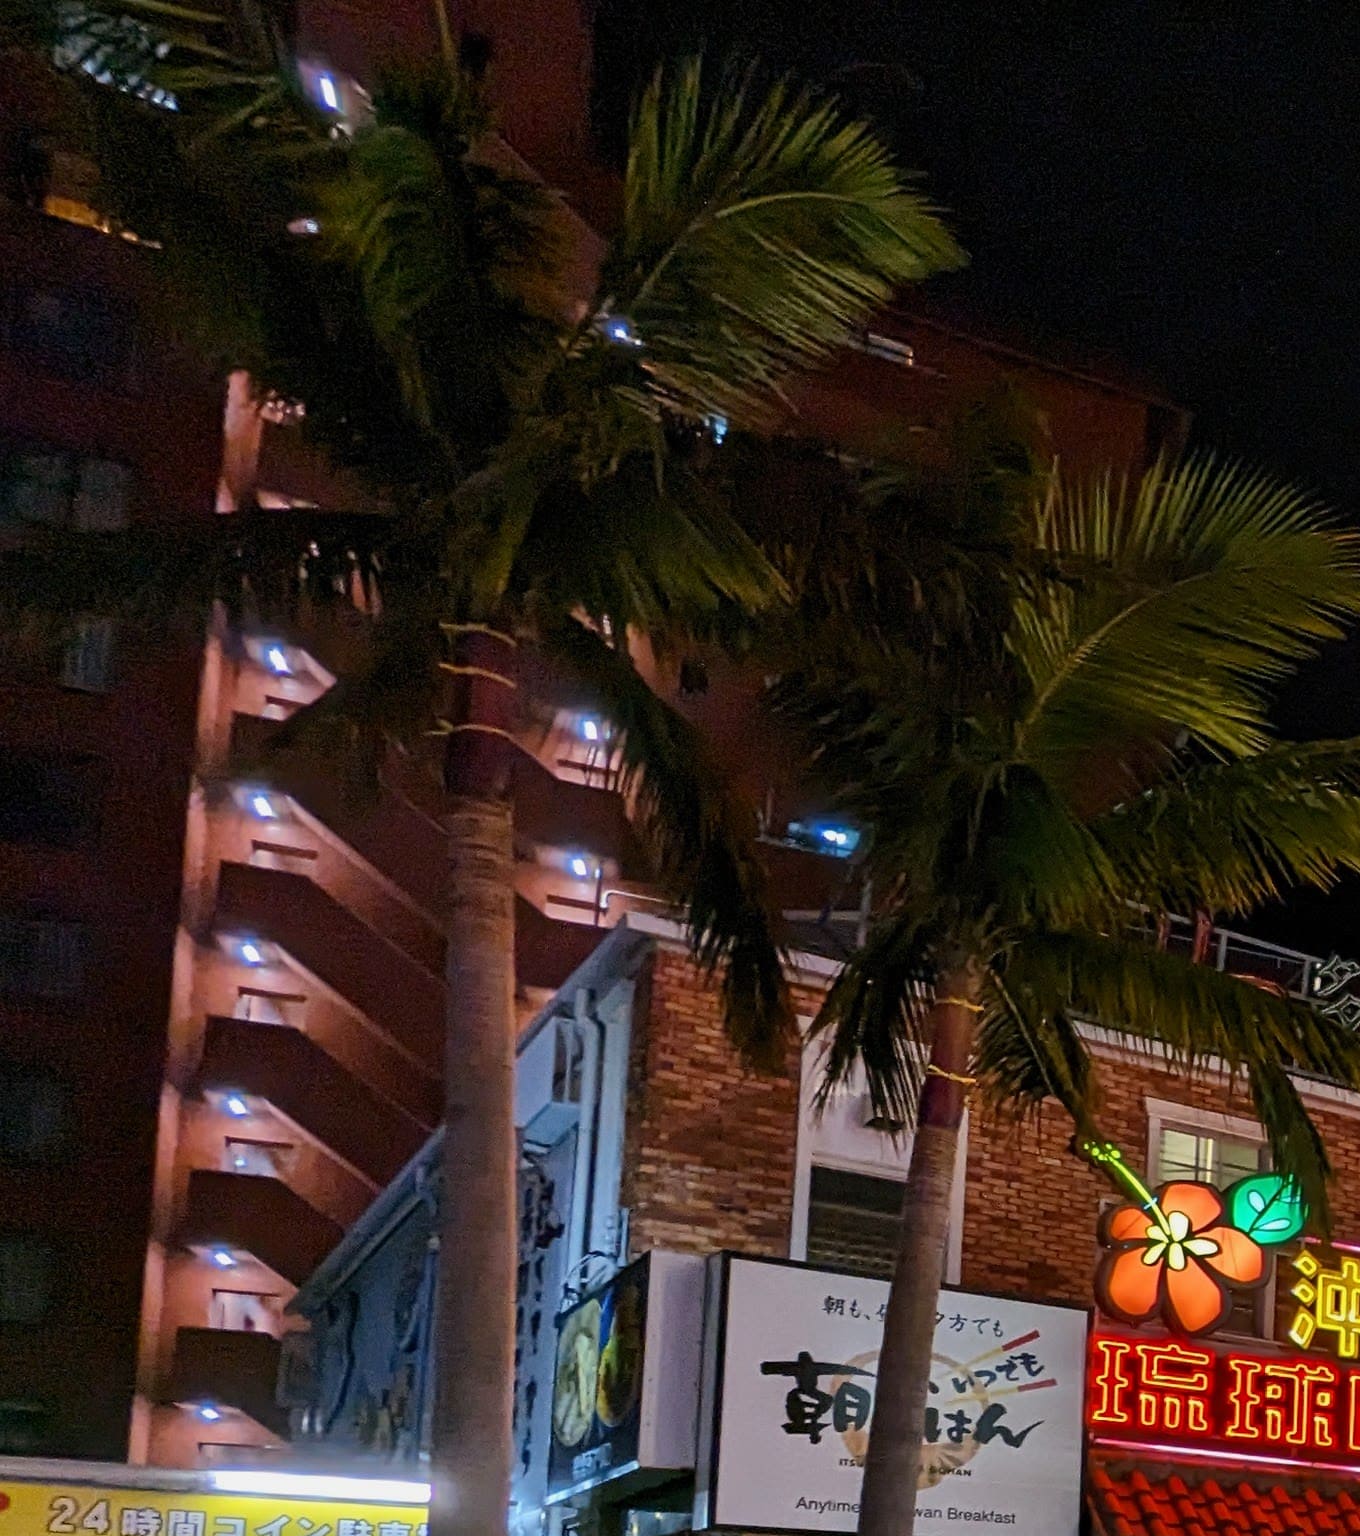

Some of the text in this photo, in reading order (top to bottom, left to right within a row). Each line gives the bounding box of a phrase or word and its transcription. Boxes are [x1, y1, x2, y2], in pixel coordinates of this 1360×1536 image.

[760, 1351, 1045, 1448] 朝はん
[947, 1508, 1016, 1524] Breakfast
